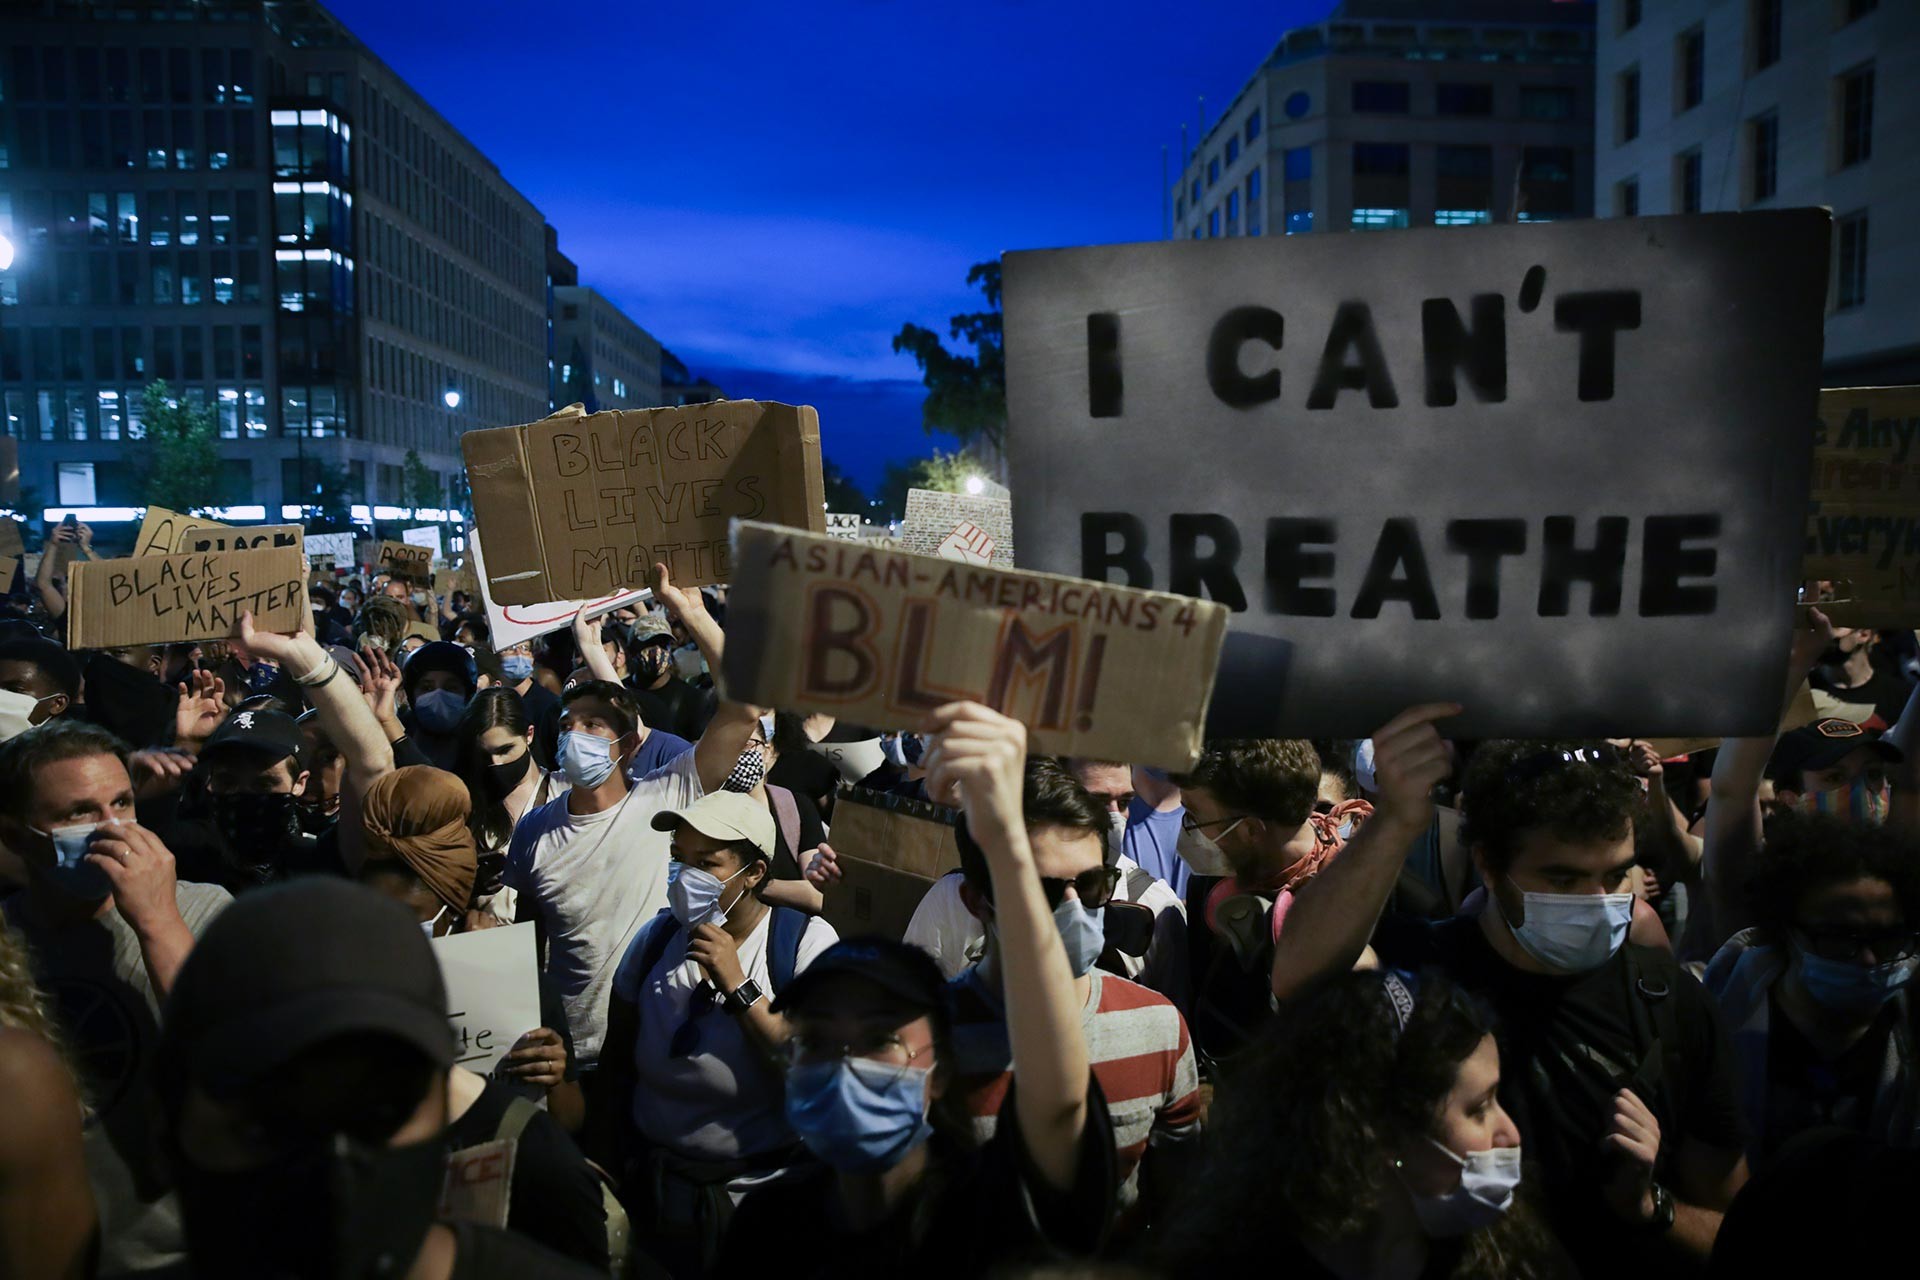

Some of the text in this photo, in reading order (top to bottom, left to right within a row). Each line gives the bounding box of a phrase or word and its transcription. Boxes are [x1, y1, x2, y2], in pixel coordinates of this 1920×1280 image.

[1087, 264, 1642, 418] I CAN'T
[553, 419, 728, 477] BLACK
[1836, 408, 1920, 463] Any
[564, 476, 765, 531] LIVES
[826, 515, 857, 528] LACK
[1805, 501, 1920, 569] very
[109, 555, 219, 607] BLACK
[573, 539, 729, 591] MATTE
[768, 541, 1199, 637] ASIAN-AMERICANS 4
[1080, 512, 1721, 620] BREATHE
[152, 571, 241, 617] LIVES
[185, 581, 301, 635] MATTER
[799, 579, 1107, 733] BLM!
[459, 1026, 494, 1050] te
